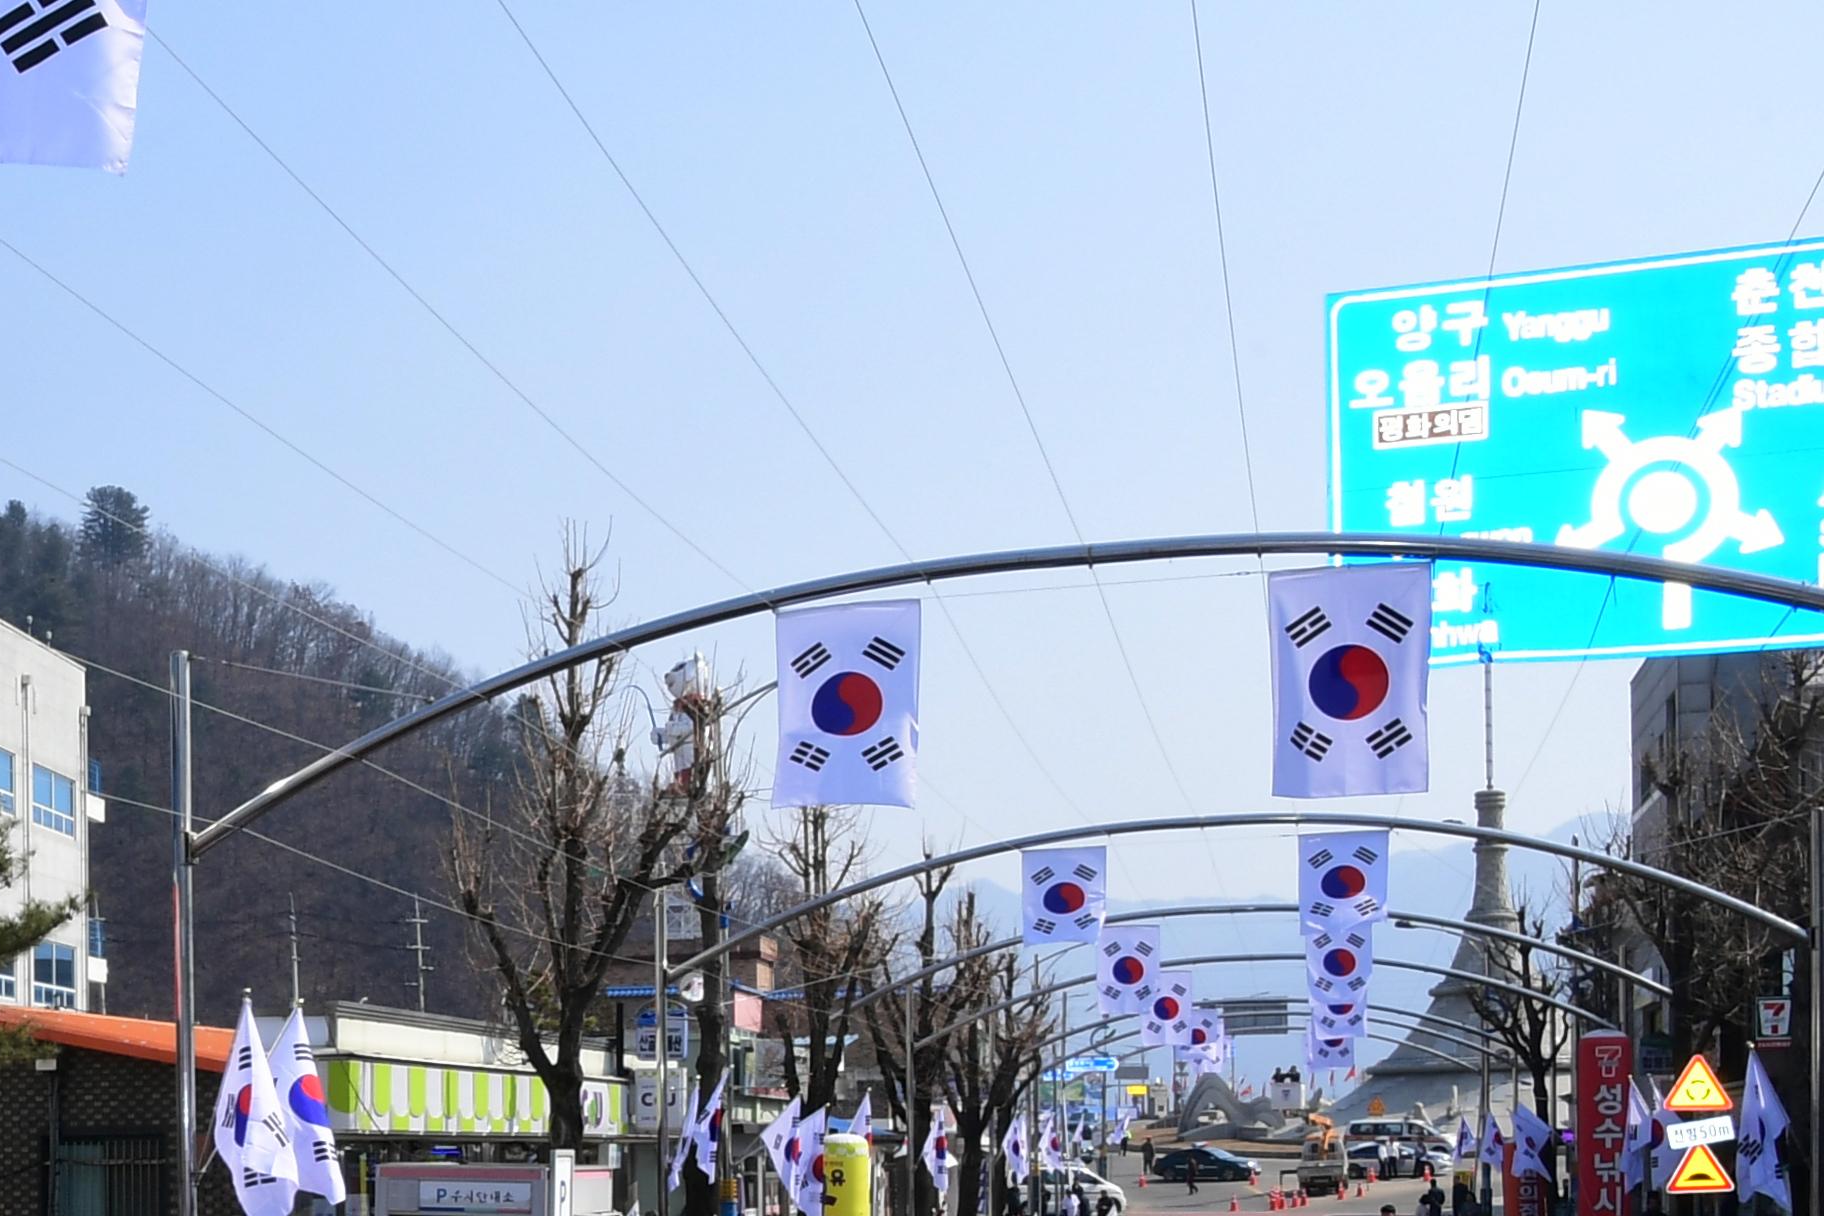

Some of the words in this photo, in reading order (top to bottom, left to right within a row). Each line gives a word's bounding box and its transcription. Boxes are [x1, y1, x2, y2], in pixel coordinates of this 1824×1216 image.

[1391, 299, 1489, 352] 양구
[1501, 307, 1611, 343] Yanggu
[436, 1188, 447, 1203] P
